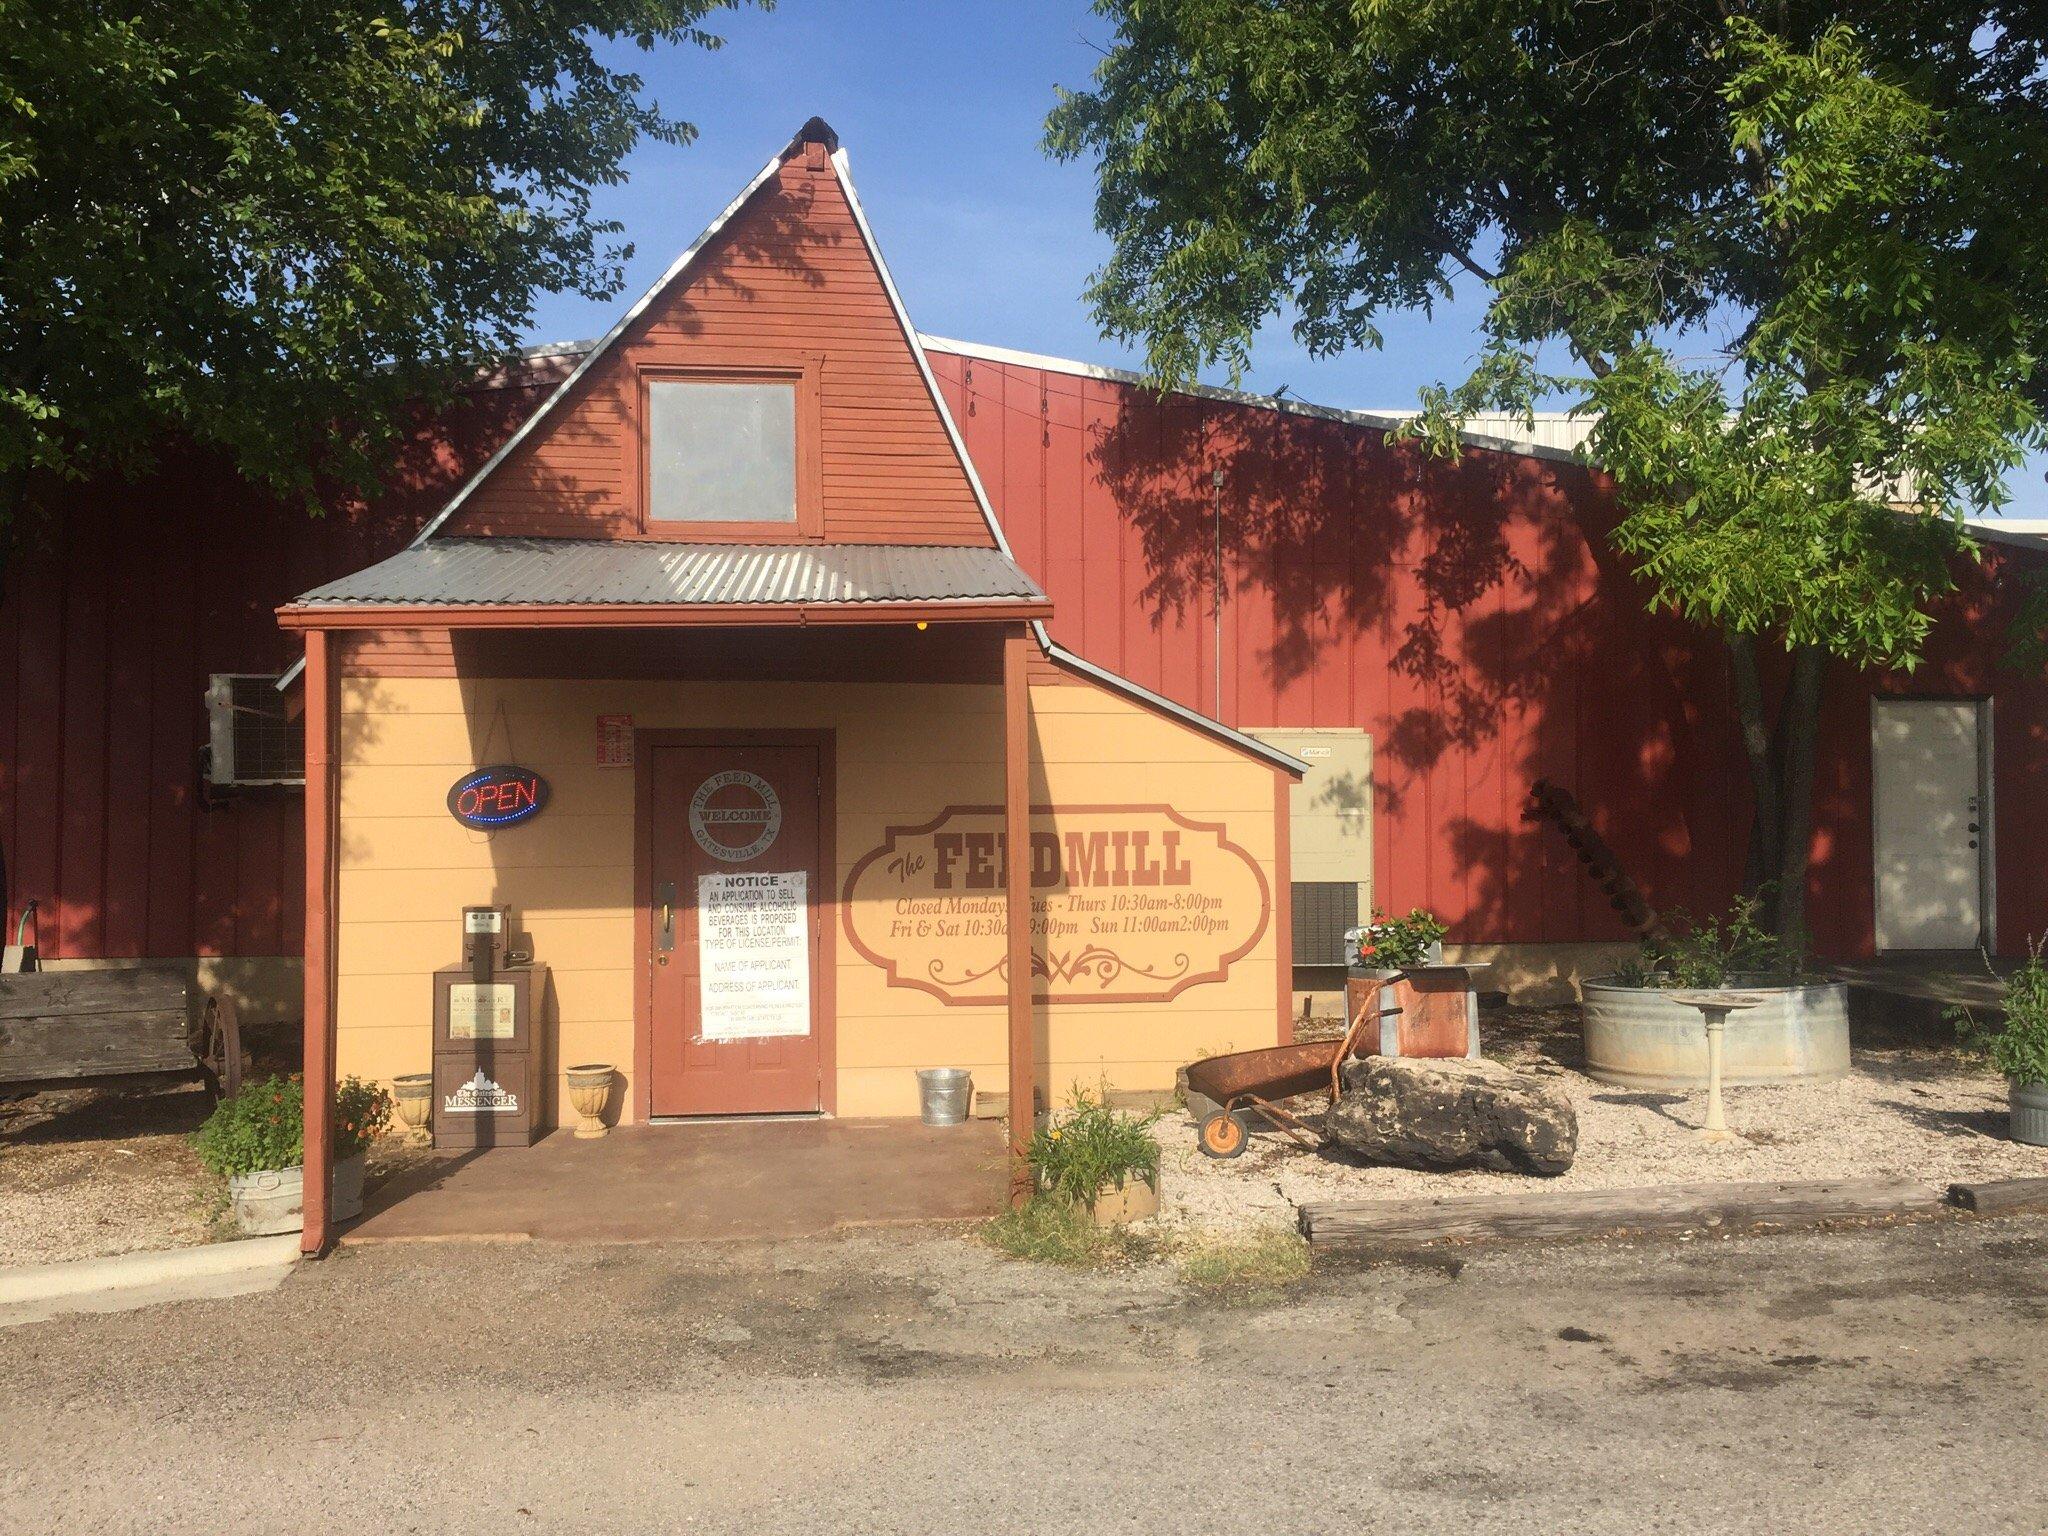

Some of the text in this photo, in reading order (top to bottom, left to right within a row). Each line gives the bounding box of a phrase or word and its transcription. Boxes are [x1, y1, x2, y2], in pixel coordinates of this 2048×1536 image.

[457, 777, 537, 816] OPEN
[693, 772, 778, 809] THE FEED MILL
[698, 810, 771, 822] WELCOME
[761, 828, 776, 843] TX
[887, 830, 1191, 889] The FEDMILL
[725, 876, 778, 888] NOTICE
[709, 888, 795, 902] AN APPLICATION TO SELL
[708, 900, 798, 914] AND CONSUME ALCOHOLIC
[895, 897, 942, 915] Closed
[1068, 894, 1106, 912] Thurs
[1111, 892, 1223, 914] 10:30am-8:00pm
[708, 912, 797, 926] BEVERAGES IS PROPOSED
[718, 925, 786, 938] FOR THIS LOCATION
[889, 919, 912, 938] Fri
[916, 919, 932, 938] &
[935, 919, 960, 937] Sat
[1090, 916, 1118, 934] Sun
[705, 939, 724, 950] TYPE
[727, 939, 737, 949] OF
[714, 961, 736, 972] NAME
[738, 960, 749, 971] OF
[708, 982, 744, 993] ADDRESS
[745, 981, 757, 992] OF
[445, 1094, 517, 1107] MESSENGER
